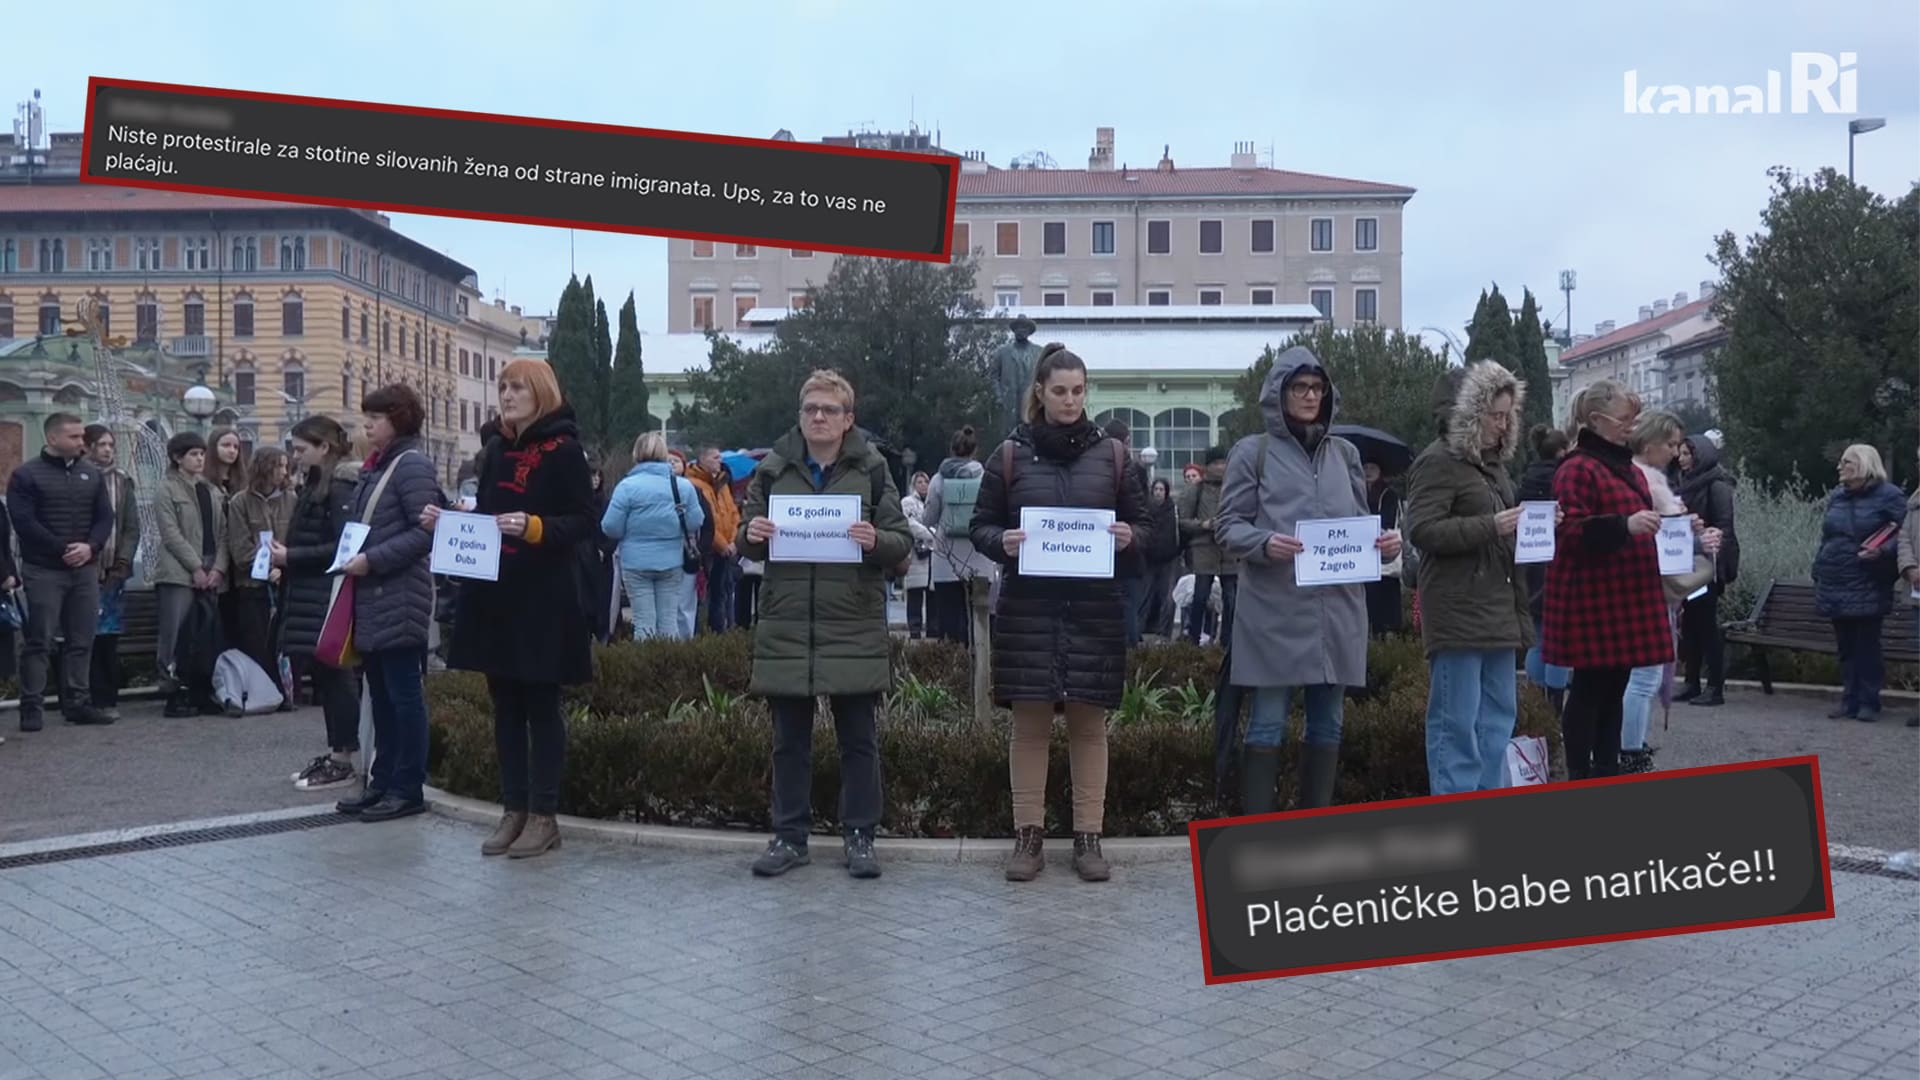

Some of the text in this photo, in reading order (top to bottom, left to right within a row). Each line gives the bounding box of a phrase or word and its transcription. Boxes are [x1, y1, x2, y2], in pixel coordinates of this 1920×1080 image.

[788, 506, 841, 519] 65 godina
[460, 523, 476, 534] K.V.
[1041, 519, 1095, 533] 78 godina
[780, 529, 811, 540] Petrinja
[1328, 528, 1350, 540] P.M.
[447, 537, 487, 551] 47 godina
[1042, 541, 1092, 553] Karlovac
[1313, 543, 1362, 557] 76 godina
[1320, 559, 1356, 573] Zagreb
